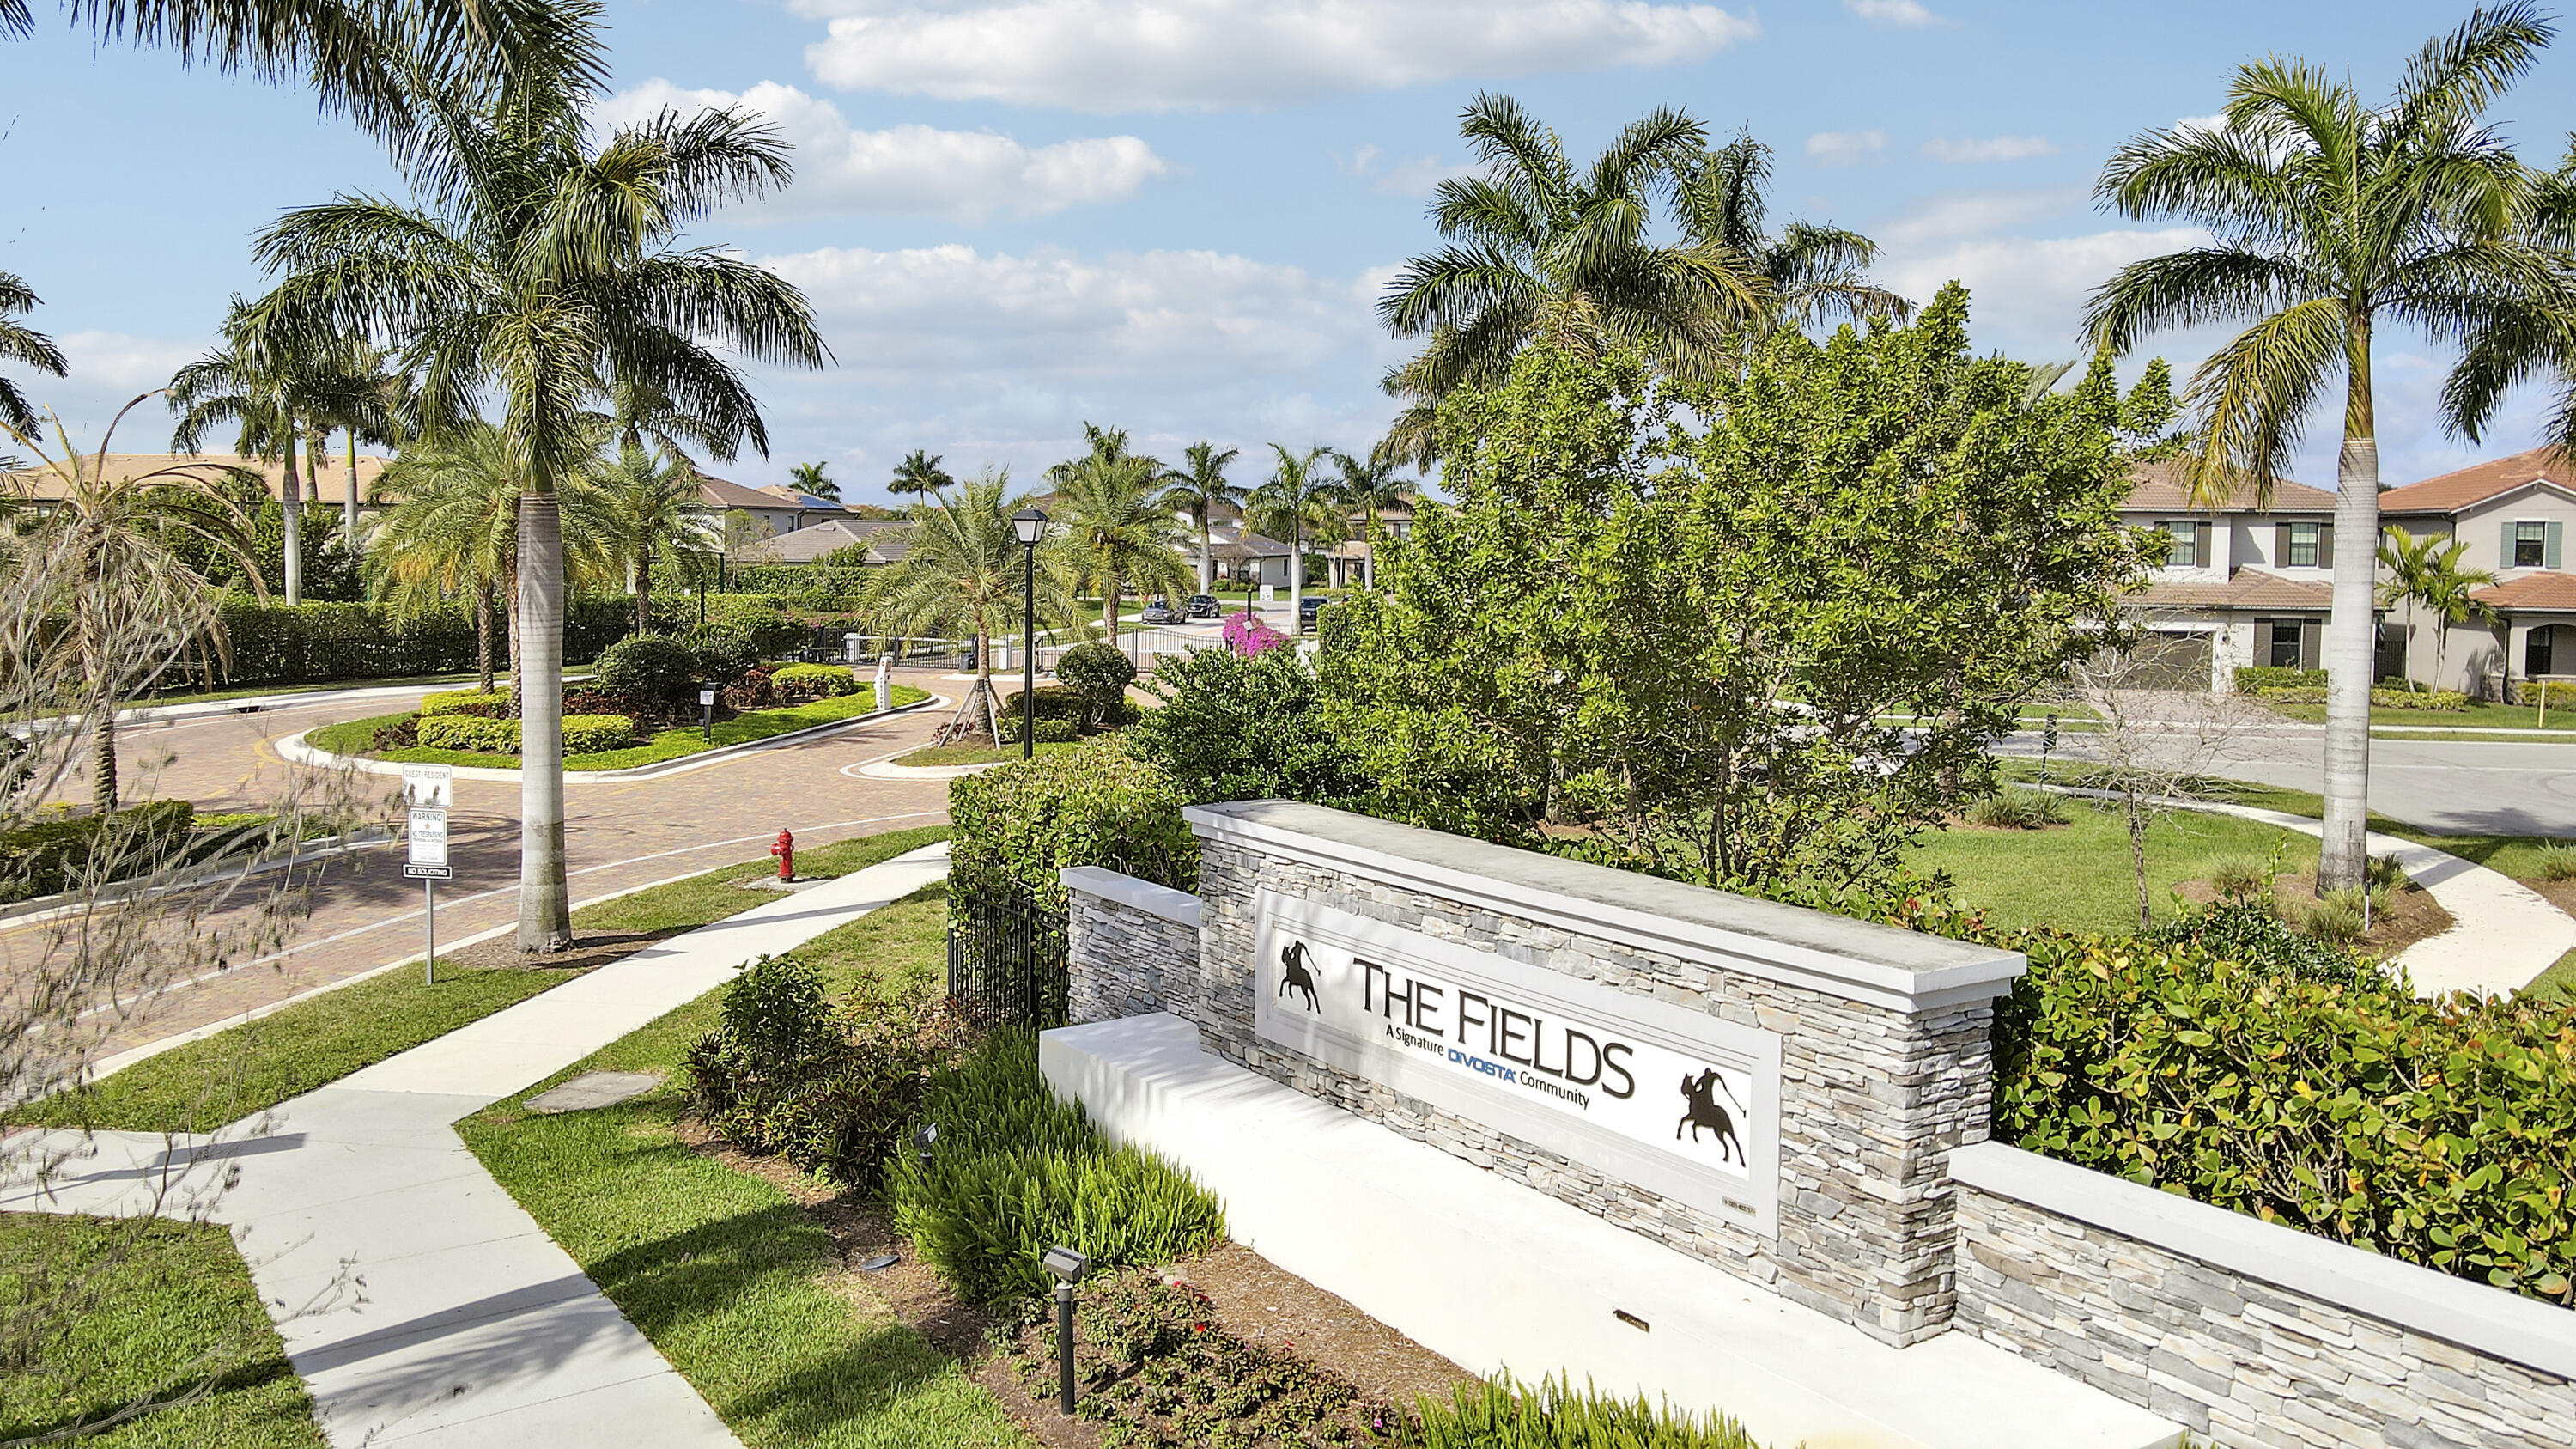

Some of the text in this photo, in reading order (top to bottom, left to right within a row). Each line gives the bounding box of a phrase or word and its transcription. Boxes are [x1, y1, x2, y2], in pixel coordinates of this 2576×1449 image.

[424, 770, 448, 779] RESIDENT
[1353, 957, 1635, 1099] THE FIELDS
[1386, 1024, 1394, 1038] A
[1396, 1027, 1444, 1056] Signature
[1520, 1070, 1590, 1110] Community
